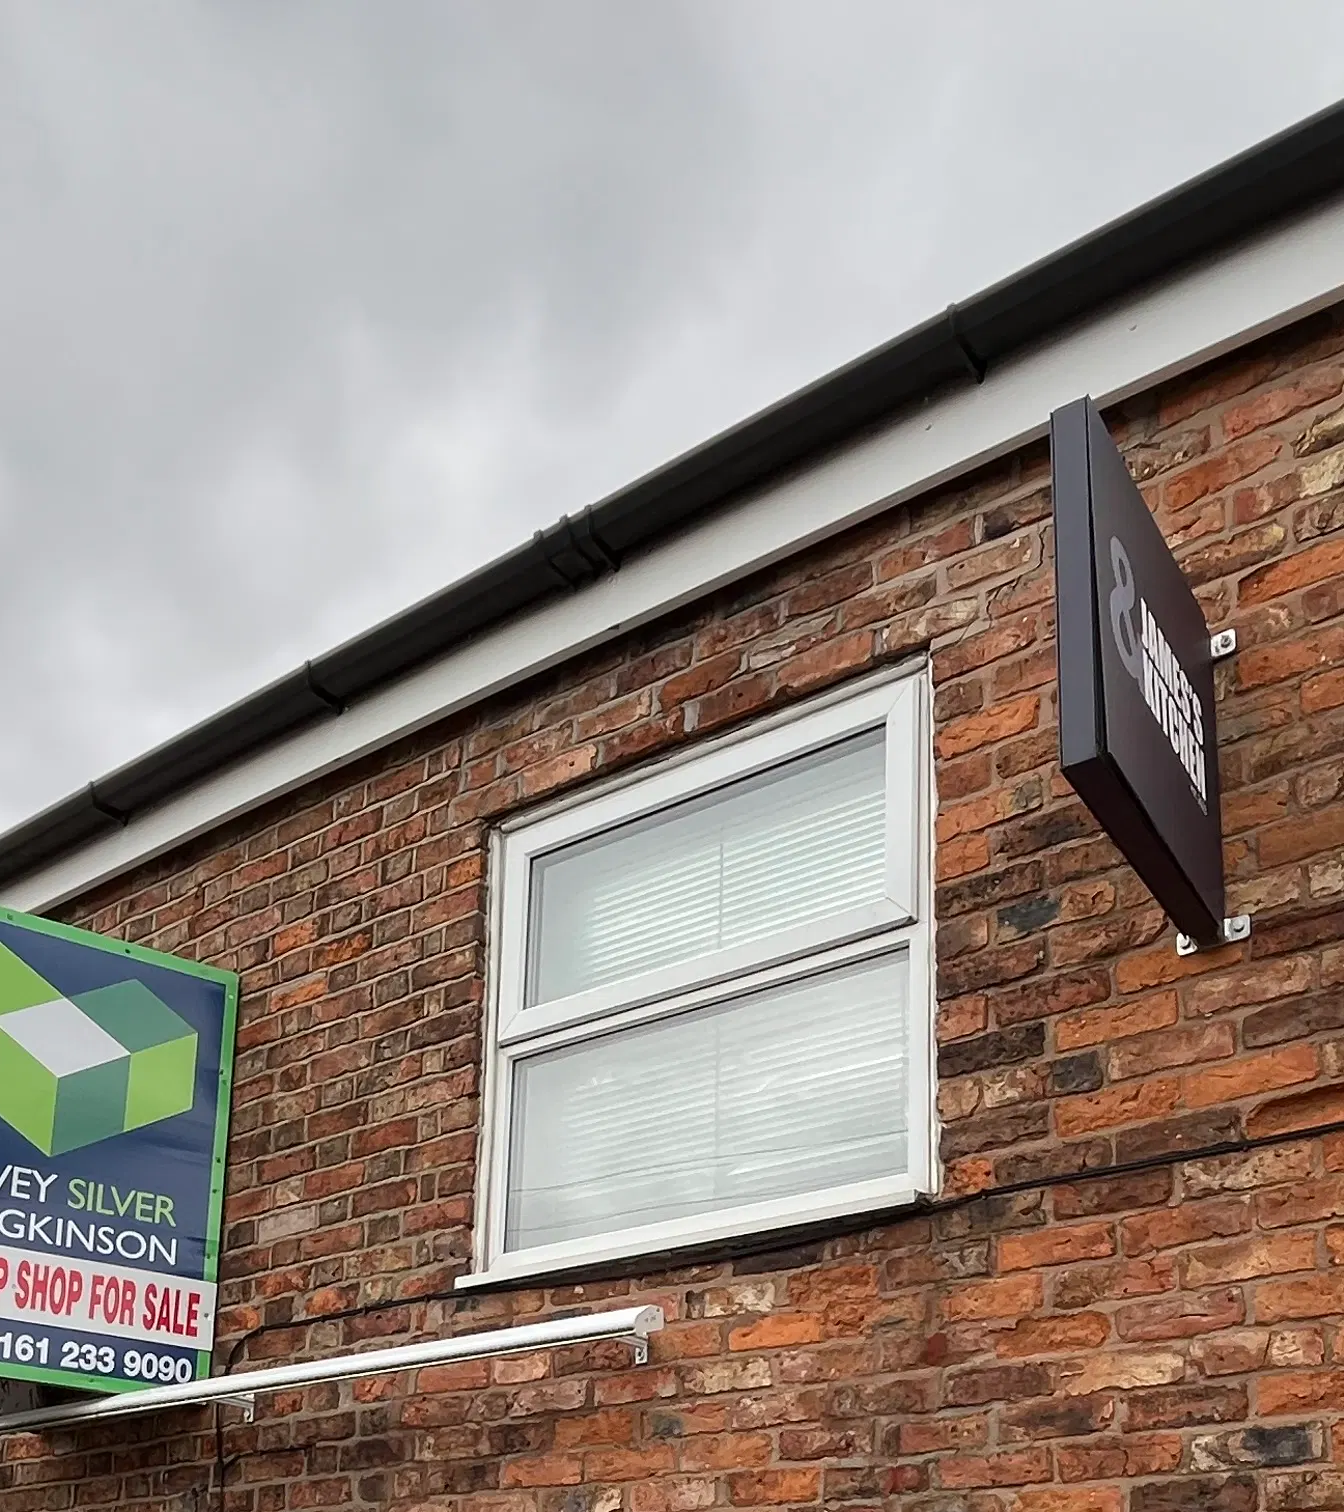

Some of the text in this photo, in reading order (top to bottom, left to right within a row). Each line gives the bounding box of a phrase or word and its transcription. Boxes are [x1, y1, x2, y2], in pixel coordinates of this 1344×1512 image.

[1142, 648, 1207, 801] KITCHEN
[67, 1178, 177, 1227] SILVER
[15, 1260, 83, 1316] SHOP
[88, 1275, 137, 1327] FOR
[142, 1283, 200, 1337] SALE
[59, 1341, 115, 1374] 233
[122, 1353, 193, 1384] 9090
